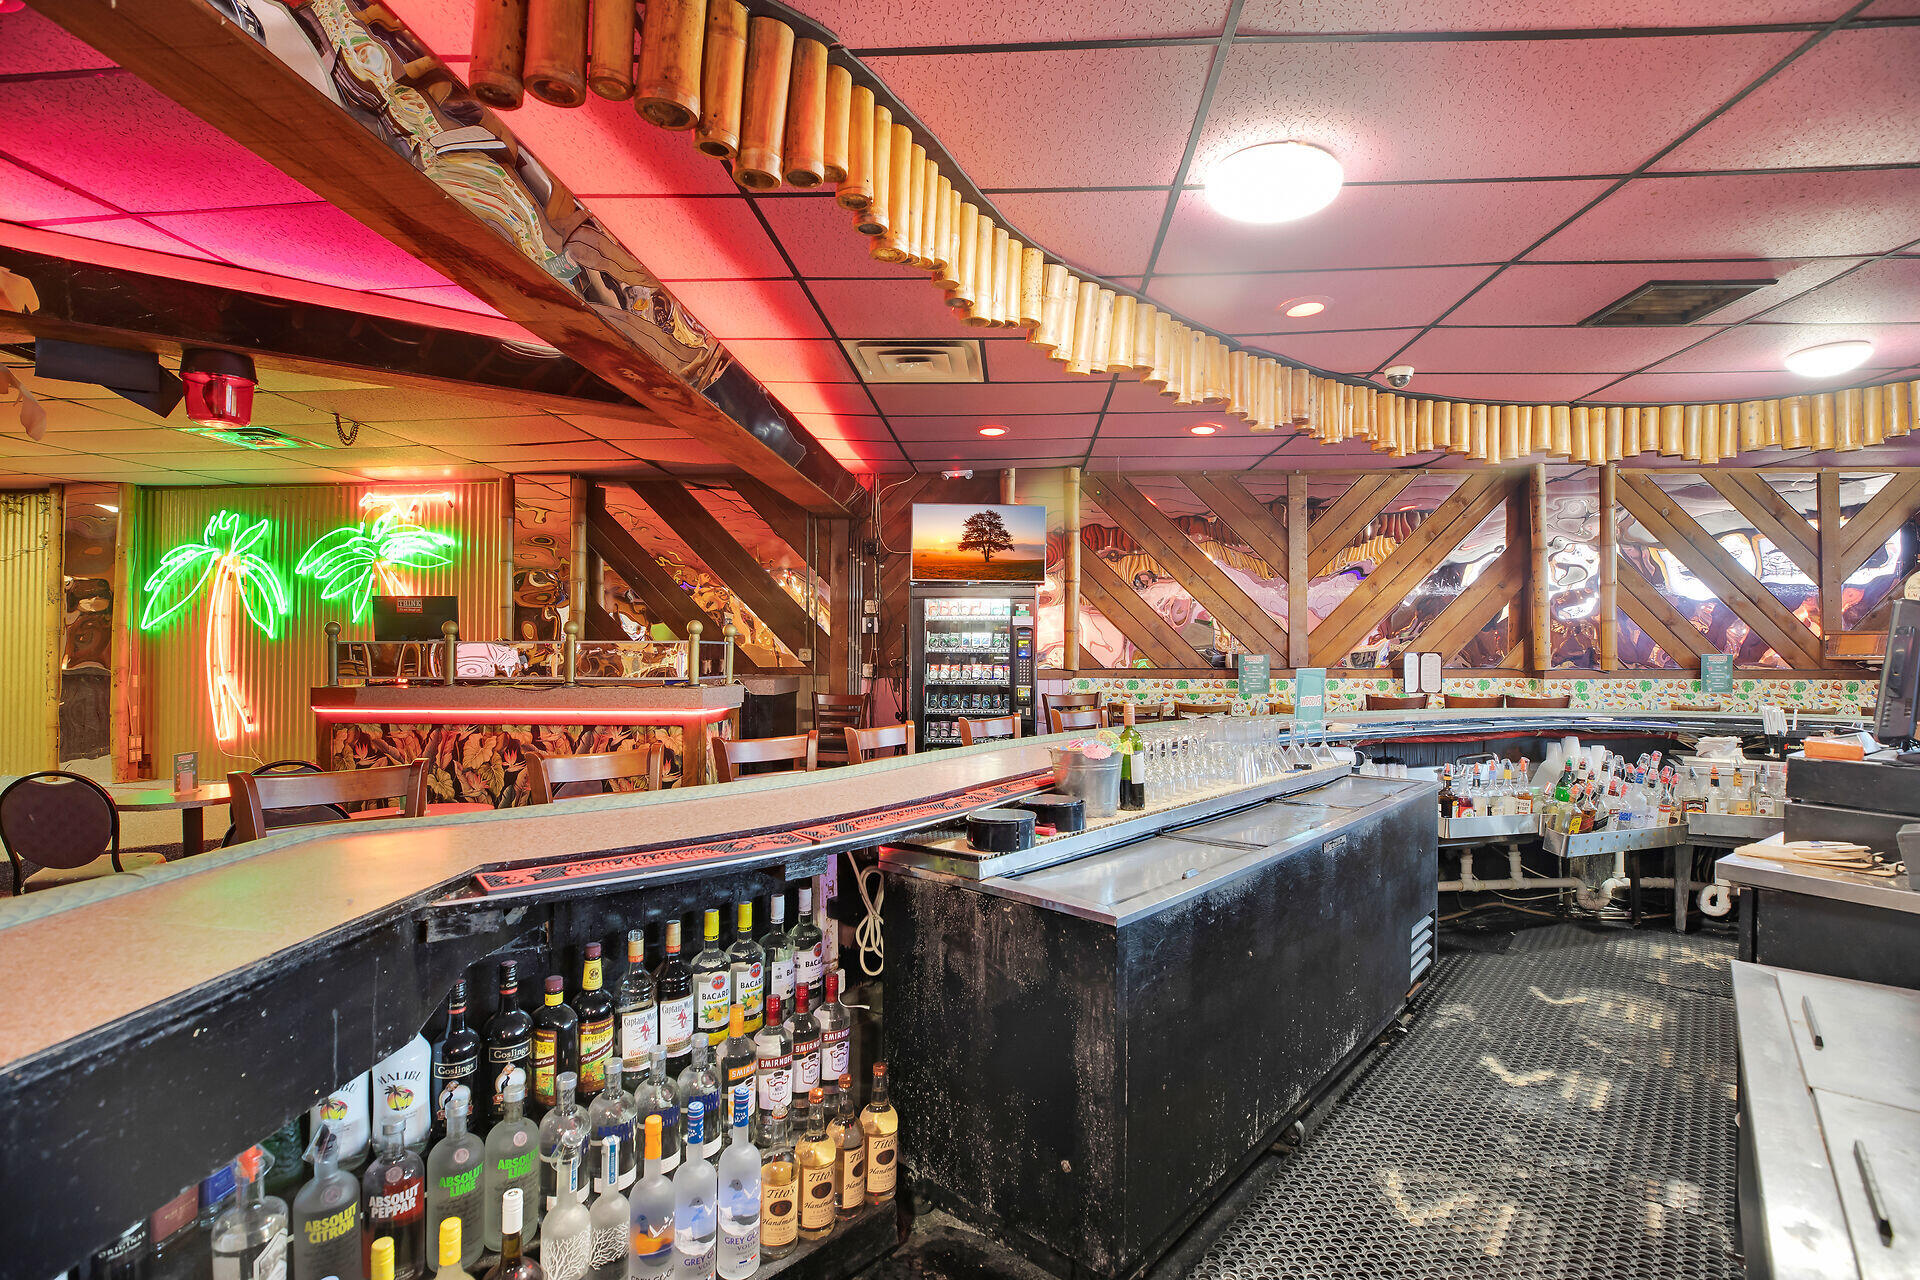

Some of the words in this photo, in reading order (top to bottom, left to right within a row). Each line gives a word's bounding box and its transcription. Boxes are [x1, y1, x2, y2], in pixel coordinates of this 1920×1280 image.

[701, 989, 729, 1000] BACARD
[494, 1046, 529, 1060] Goslings
[437, 1063, 474, 1076] Goslings
[732, 1061, 756, 1078] SMIRN
[439, 1161, 484, 1188] ABSOLUT
[369, 1182, 420, 1208] ABSOLUT
[449, 1180, 477, 1197] LIME
[767, 1185, 796, 1199] Tito's
[304, 1201, 358, 1233] ABSOLUT
[371, 1198, 416, 1219] PEPPAR
[309, 1217, 355, 1244] CITRON
[725, 1234, 745, 1245] GREY
[684, 1255, 706, 1266] GREY
